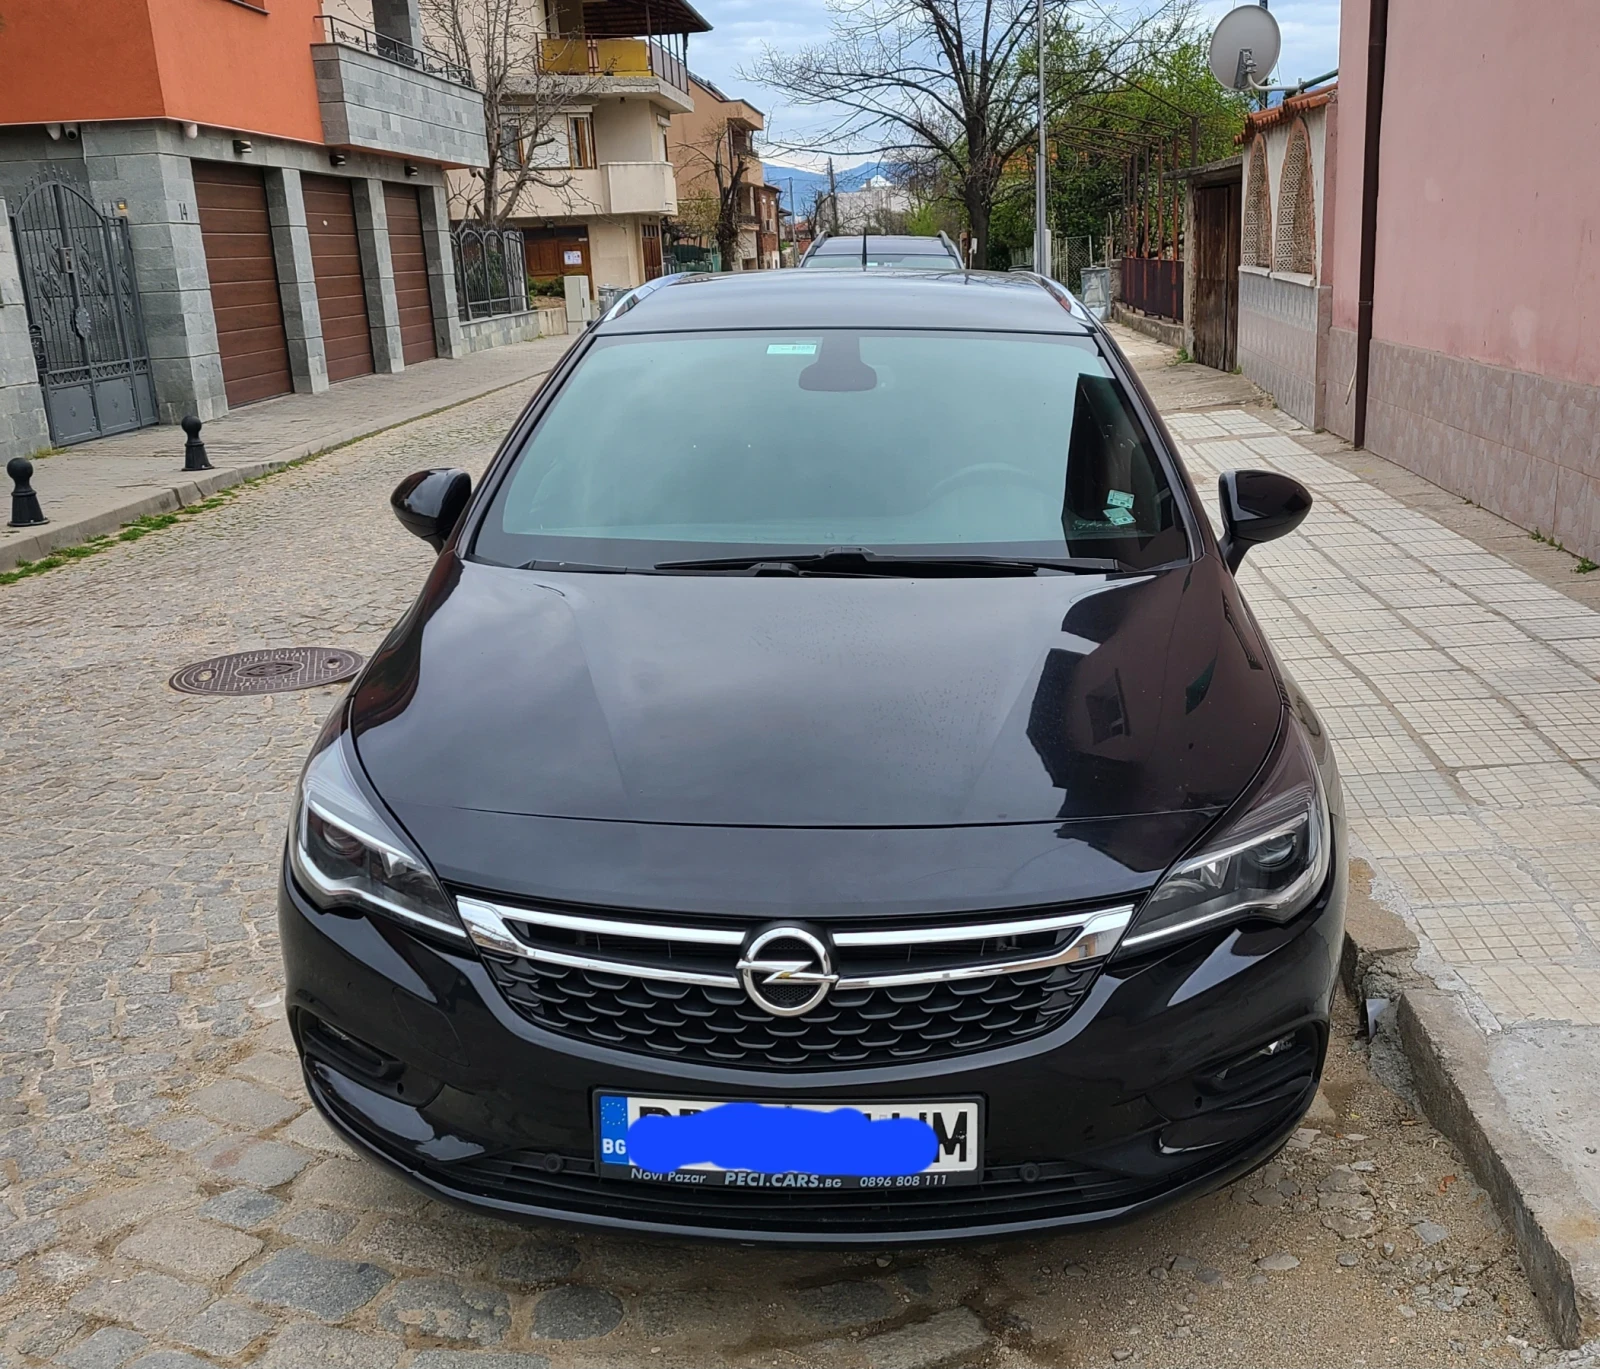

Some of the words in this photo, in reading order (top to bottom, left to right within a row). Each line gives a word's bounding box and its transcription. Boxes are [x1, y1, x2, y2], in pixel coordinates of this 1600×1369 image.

[178, 202, 188, 221] 14
[602, 1138, 627, 1155] BG
[631, 1168, 663, 1181] Novi
[667, 1171, 707, 1184] Pazar
[860, 1176, 892, 1188] 0896
[895, 1175, 920, 1187] 808
[925, 1174, 947, 1186] 111
